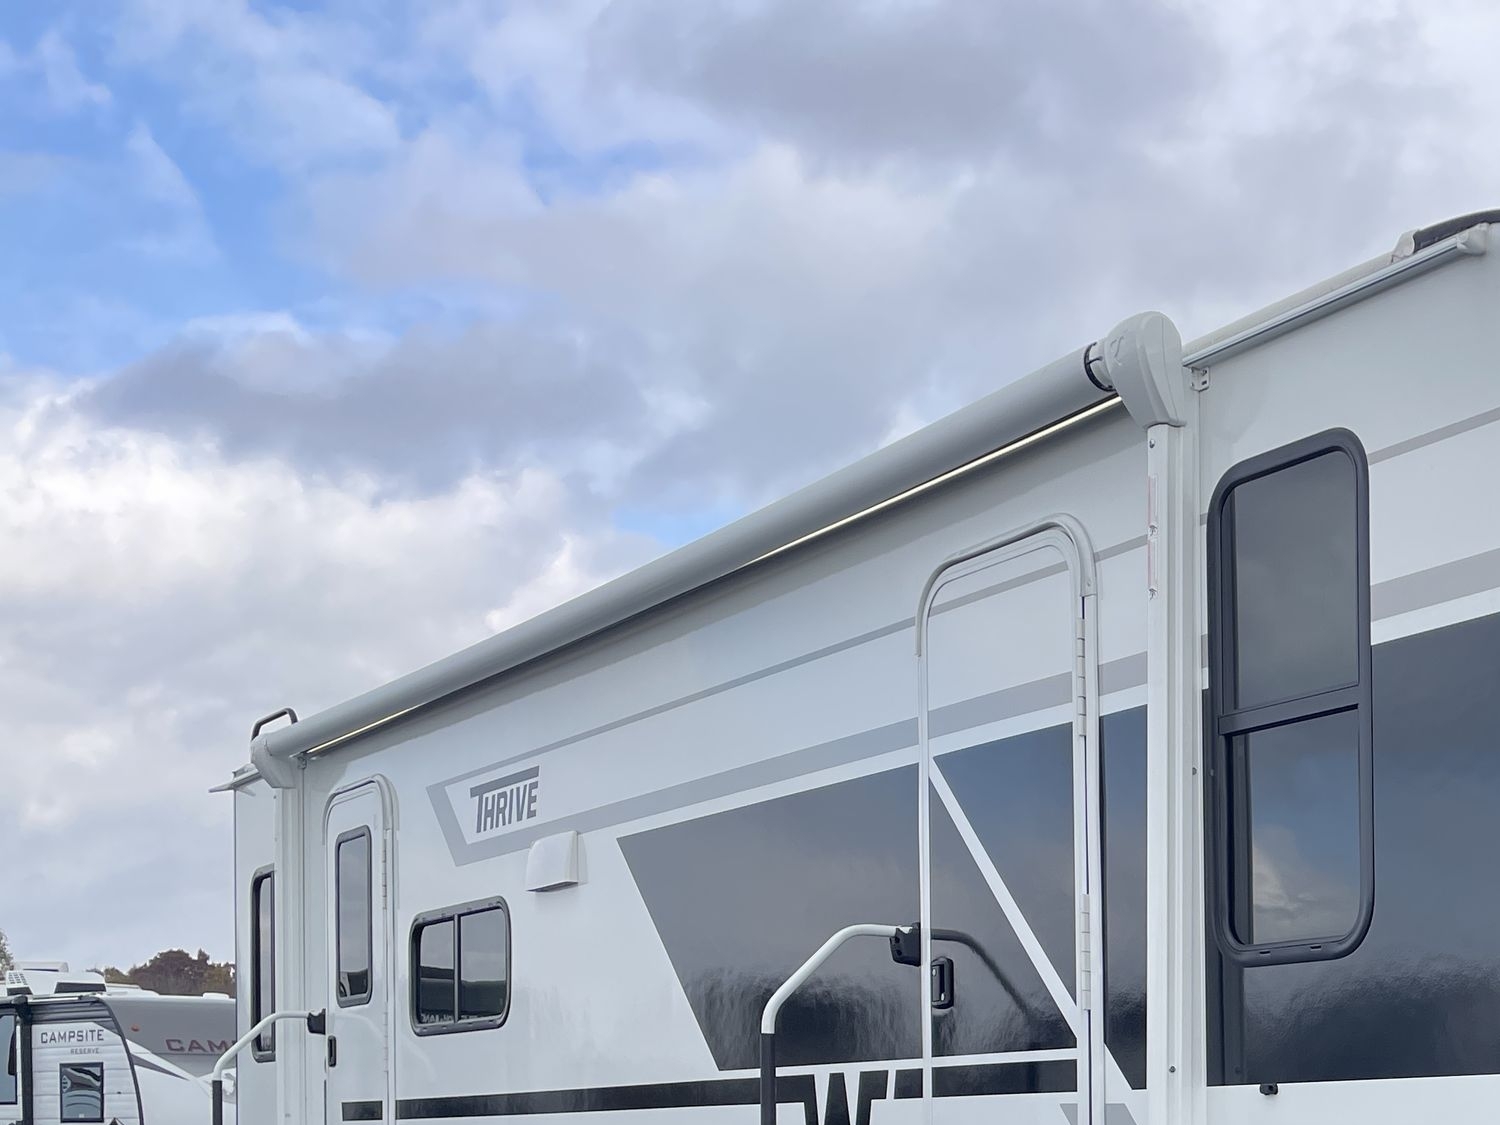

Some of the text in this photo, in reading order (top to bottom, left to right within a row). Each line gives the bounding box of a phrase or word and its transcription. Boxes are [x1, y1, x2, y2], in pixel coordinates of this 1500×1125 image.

[470, 765, 540, 834] THRIVE
[40, 1029, 104, 1044] CAMPSITE
[165, 1039, 237, 1053] CAM
